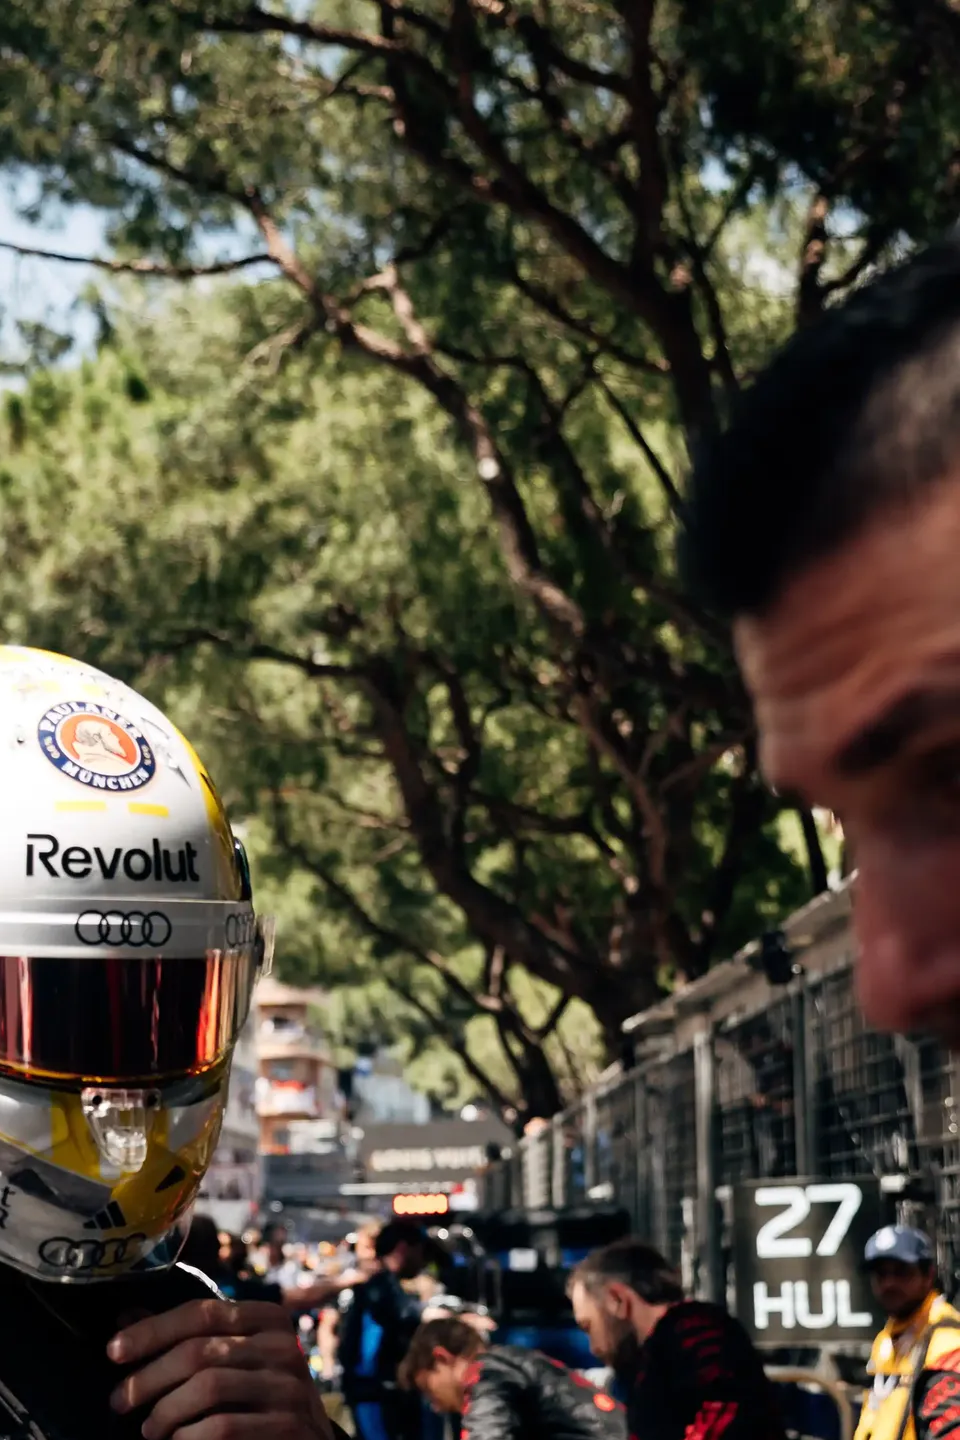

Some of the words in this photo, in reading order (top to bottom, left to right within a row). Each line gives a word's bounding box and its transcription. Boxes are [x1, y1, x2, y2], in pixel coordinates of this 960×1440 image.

[26, 833, 200, 882] Revolut
[755, 1183, 863, 1259] 27
[753, 1279, 874, 1330] HUL
